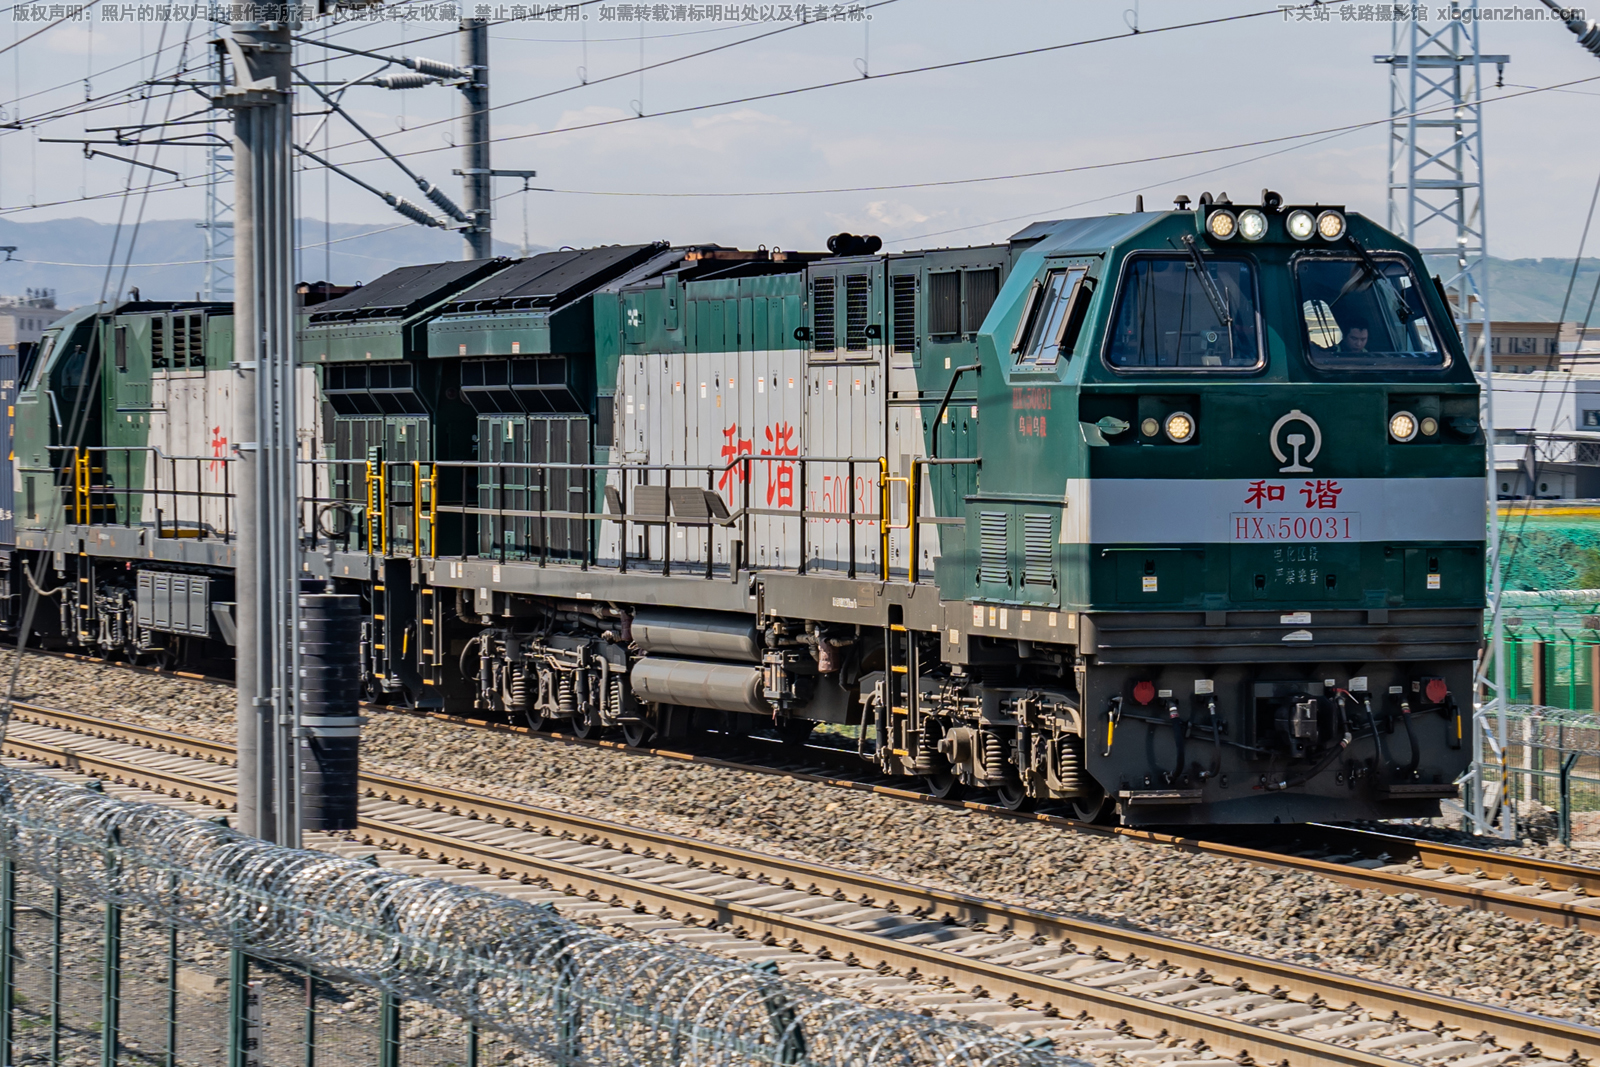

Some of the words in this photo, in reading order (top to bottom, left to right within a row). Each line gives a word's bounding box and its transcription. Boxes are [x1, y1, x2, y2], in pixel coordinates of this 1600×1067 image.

[718, 421, 798, 508] 和谐
[1244, 480, 1343, 509] 和谐
[1235, 517, 1352, 539] HXN50031
